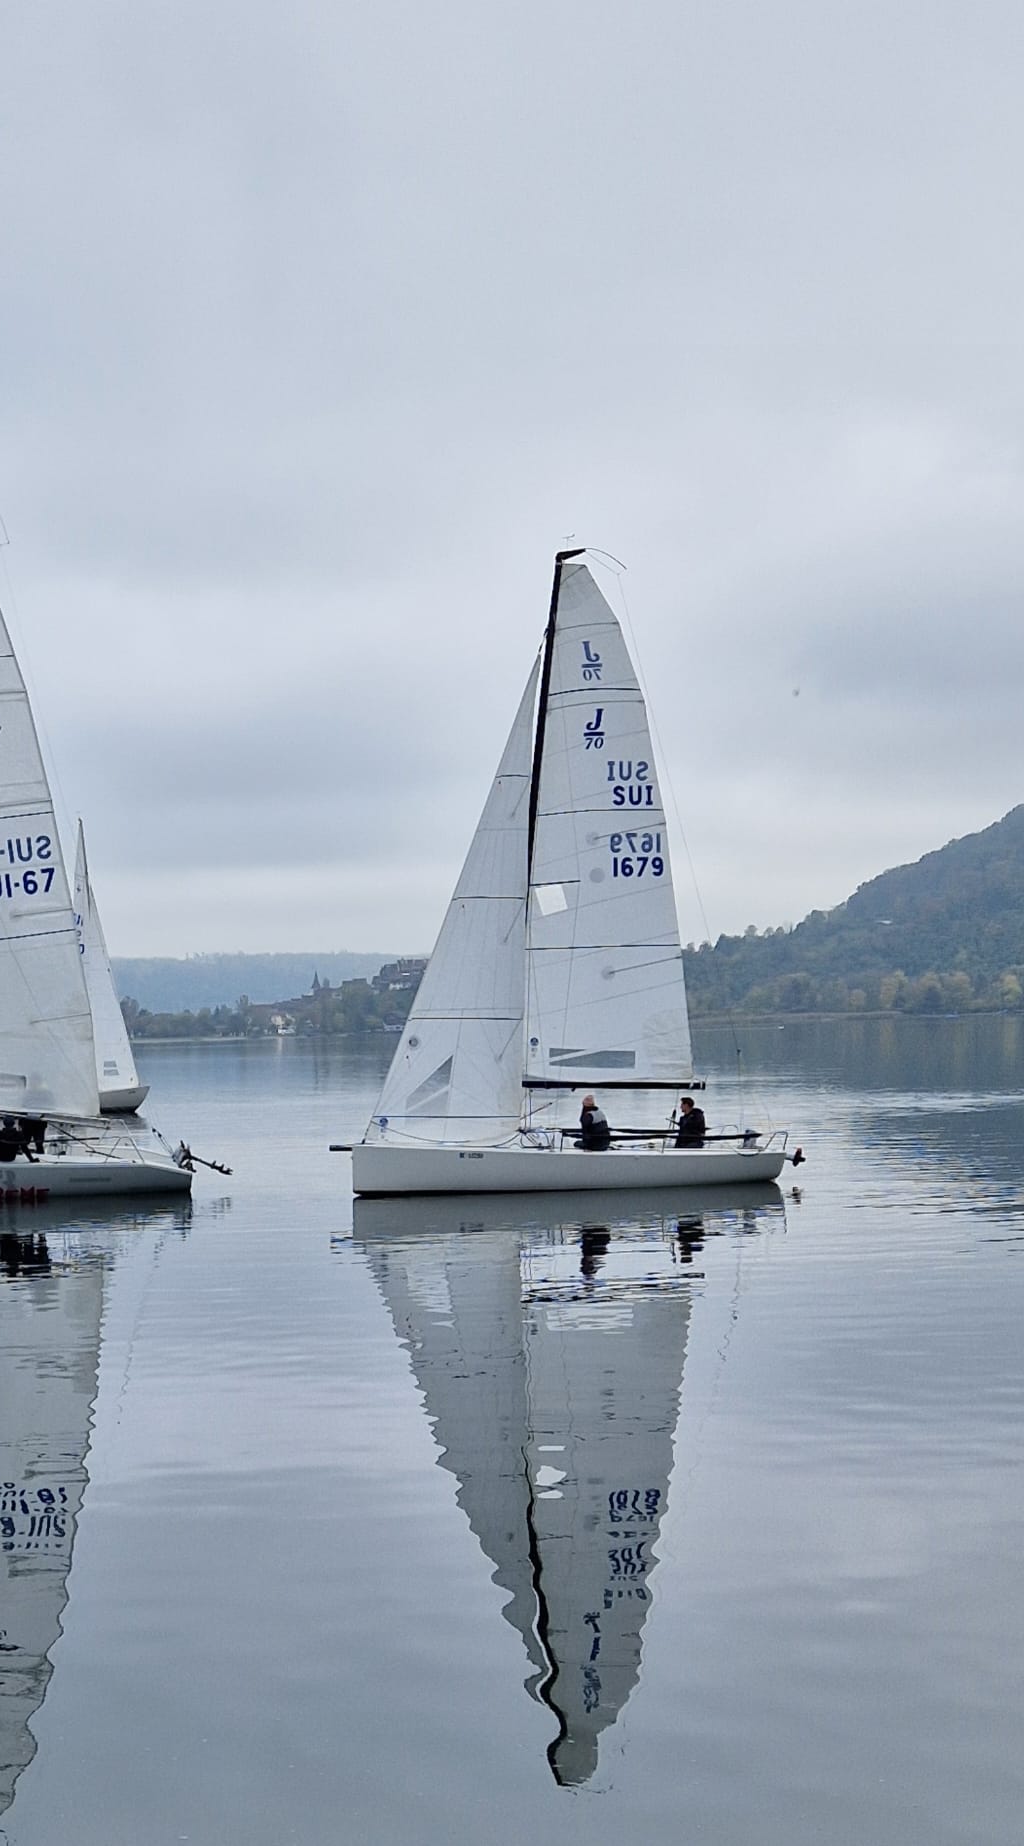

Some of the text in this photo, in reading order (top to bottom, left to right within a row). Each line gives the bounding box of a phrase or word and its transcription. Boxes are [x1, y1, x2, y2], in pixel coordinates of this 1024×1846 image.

[585, 708, 604, 731] J
[584, 736, 604, 750] 70
[612, 784, 654, 806] SUI
[612, 856, 664, 878] 1679
